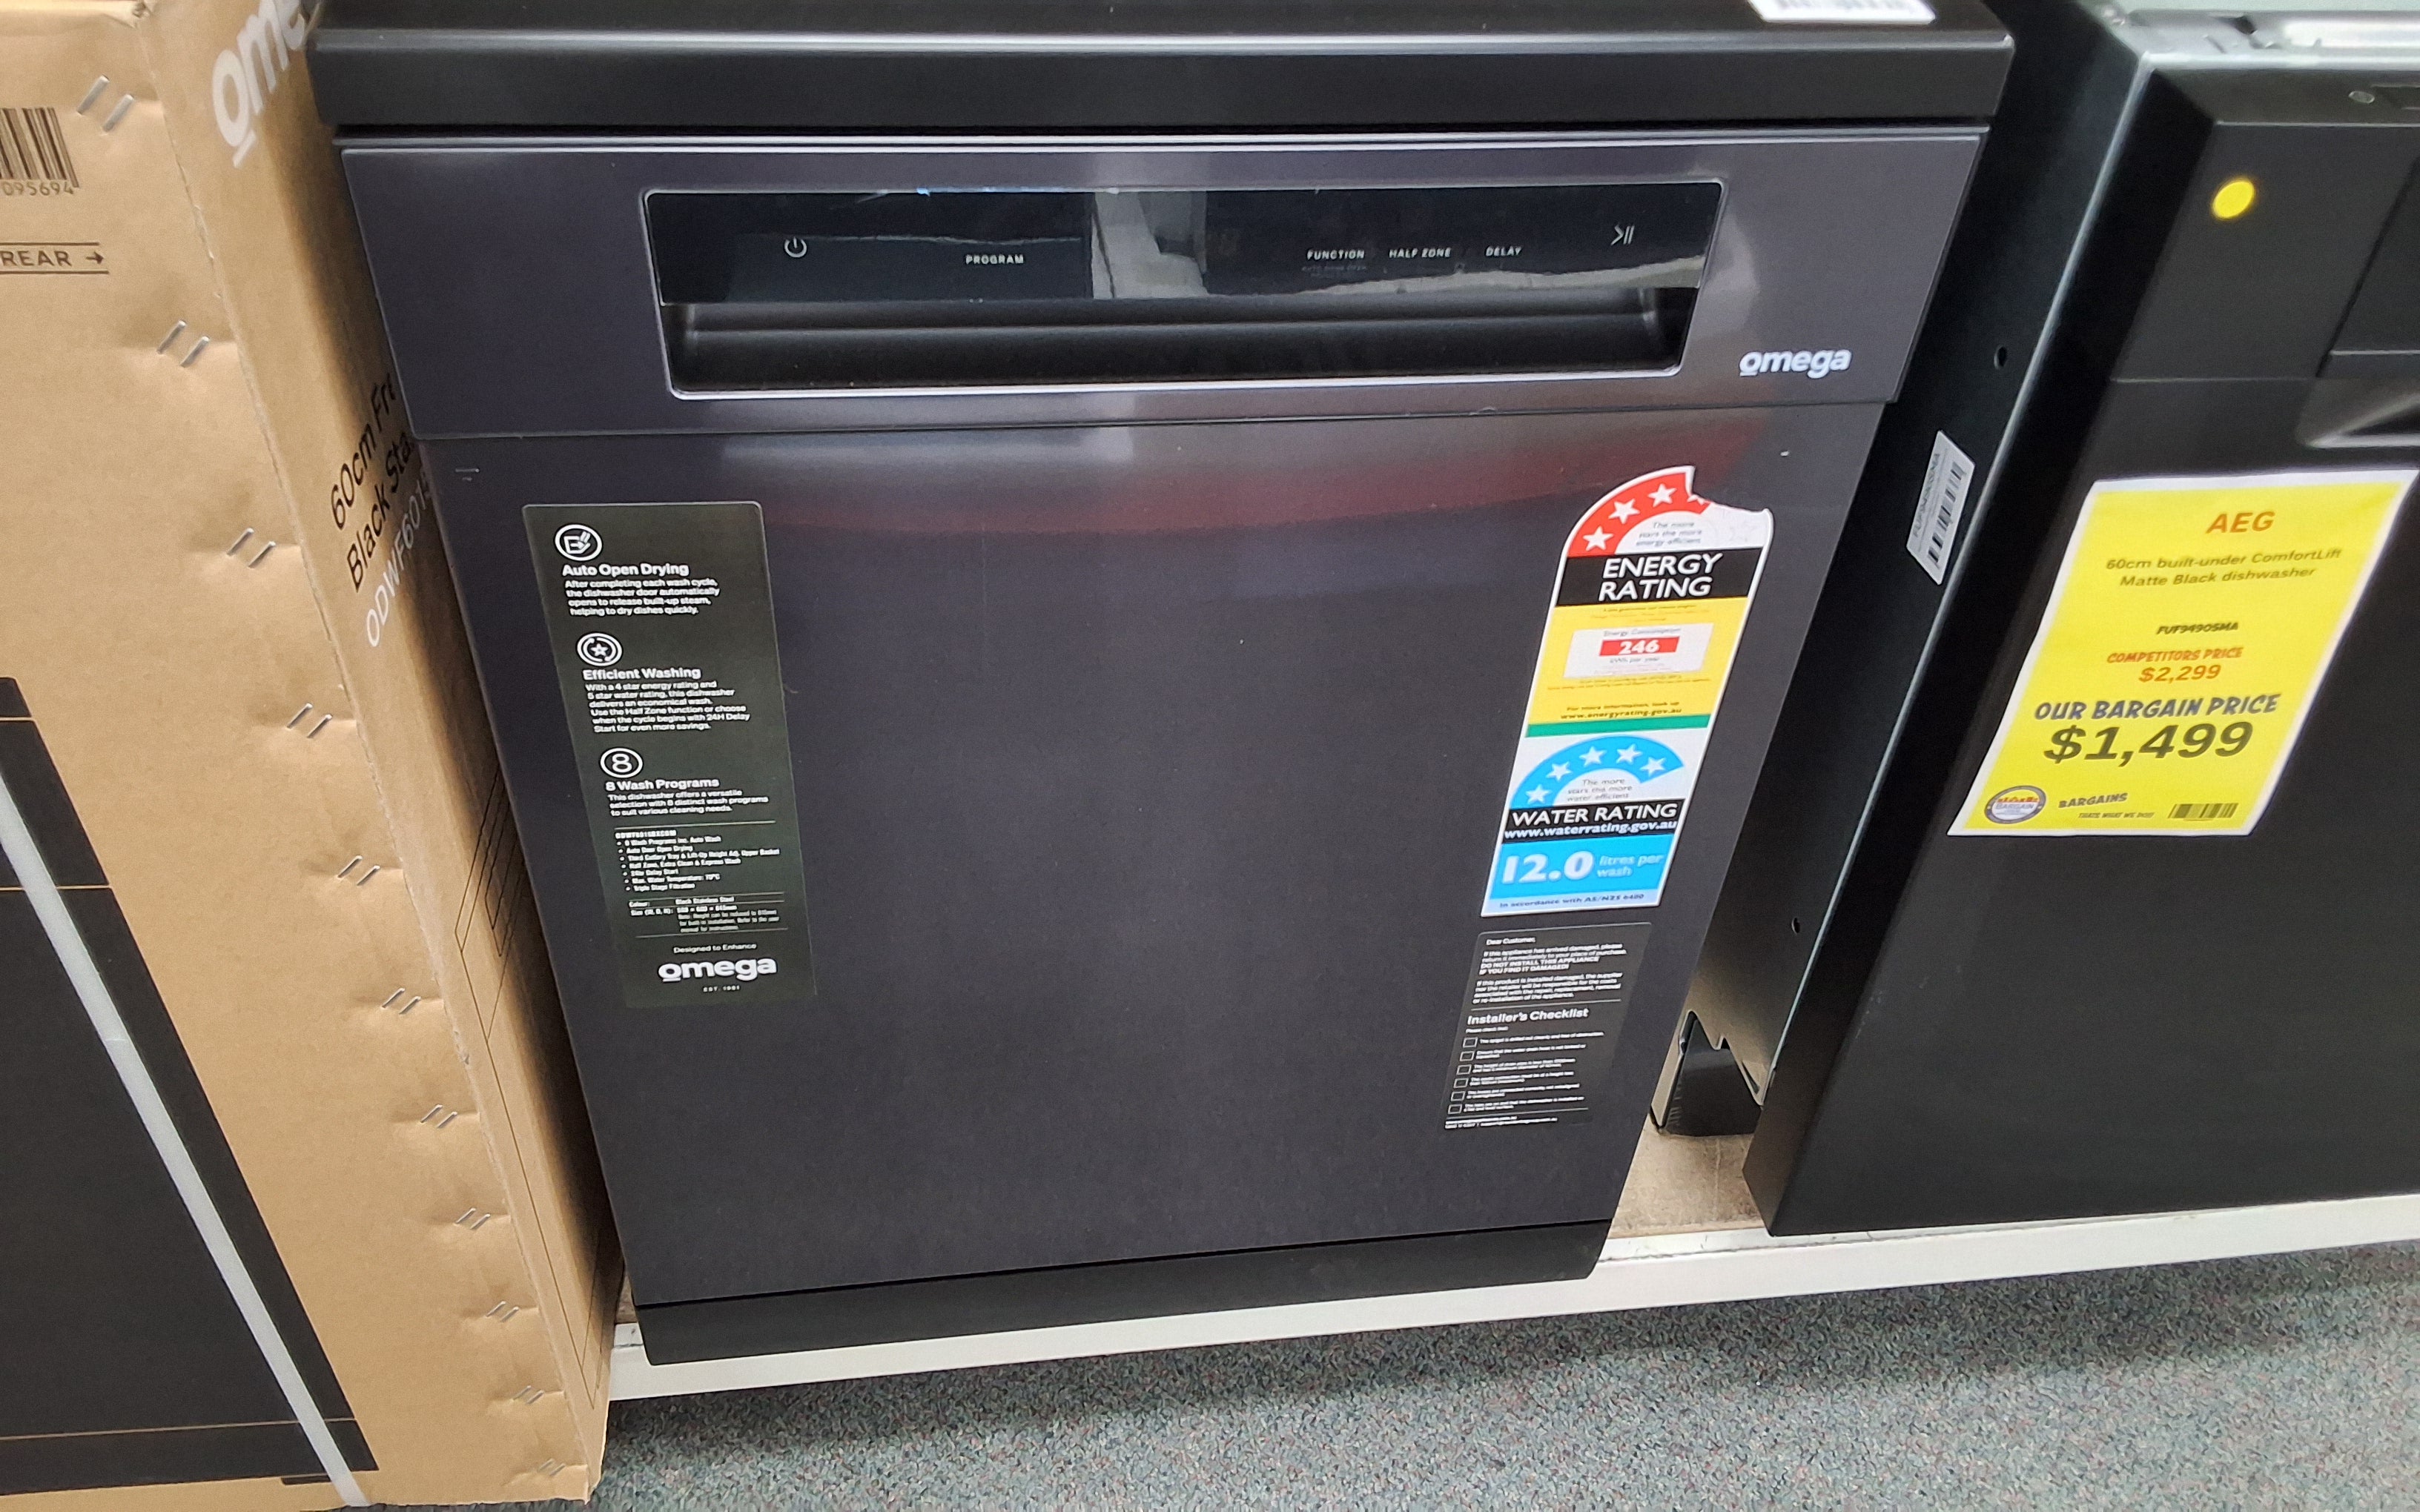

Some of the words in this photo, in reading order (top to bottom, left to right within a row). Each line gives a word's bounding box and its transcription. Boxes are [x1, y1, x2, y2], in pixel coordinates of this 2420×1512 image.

[1, 182, 74, 196] 095694
[0, 251, 72, 266] REAR
[965, 254, 1025, 265] PROGRAM
[1306, 250, 1365, 260] FUNCTION
[1389, 248, 1418, 258] HALF
[1421, 248, 1452, 257] ZONE
[1485, 247, 1522, 256] DELAY
[1738, 348, 1851, 378] omega
[331, 423, 377, 531] 60cm
[2205, 511, 2276, 534] AEG
[346, 483, 391, 593] Black
[1603, 553, 1723, 579] ENERGY
[2106, 557, 2152, 570] 60cm
[2158, 554, 2247, 568] built-under
[2252, 548, 2342, 564] ComfortLift
[563, 565, 597, 576] Auto
[599, 564, 639, 577] Open
[641, 563, 690, 576] Drying
[2120, 574, 2168, 586] Matte
[2173, 572, 2217, 585] Black
[2222, 567, 2316, 582] dishwasher
[589, 580, 641, 588] completing
[1599, 577, 1713, 601] RATING
[618, 607, 632, 615] dry
[1619, 640, 1659, 654] 246
[2106, 650, 2201, 663] COMPETITORS
[2204, 647, 2244, 660] PRICE
[583, 669, 640, 680] Efficient
[641, 668, 701, 679] Washing
[2138, 664, 2221, 683] $2,299
[1561, 708, 1682, 719] www.energyrating.gov.au
[2034, 701, 2087, 720] OUR
[2092, 697, 2204, 720] BARGAIN
[2206, 693, 2281, 716] PRICE
[2043, 721, 2253, 768] $1,499
[612, 753, 632, 772] 8
[606, 782, 615, 791] 8
[617, 780, 654, 790] Wash
[655, 780, 719, 789] Programs
[2058, 792, 2129, 809] BARGAINS
[1512, 808, 1589, 826] WATER
[1594, 803, 1679, 821] RATING
[1504, 820, 1677, 839] www.waterrating.gov.au
[1502, 851, 1593, 884] 12.0
[1599, 855, 1635, 866] litres
[1637, 854, 1664, 866] per
[1597, 866, 1632, 878] wash
[658, 958, 777, 982] omega
[1467, 1013, 1527, 1025] Installer's
[1530, 1009, 1589, 1021] Checklist
